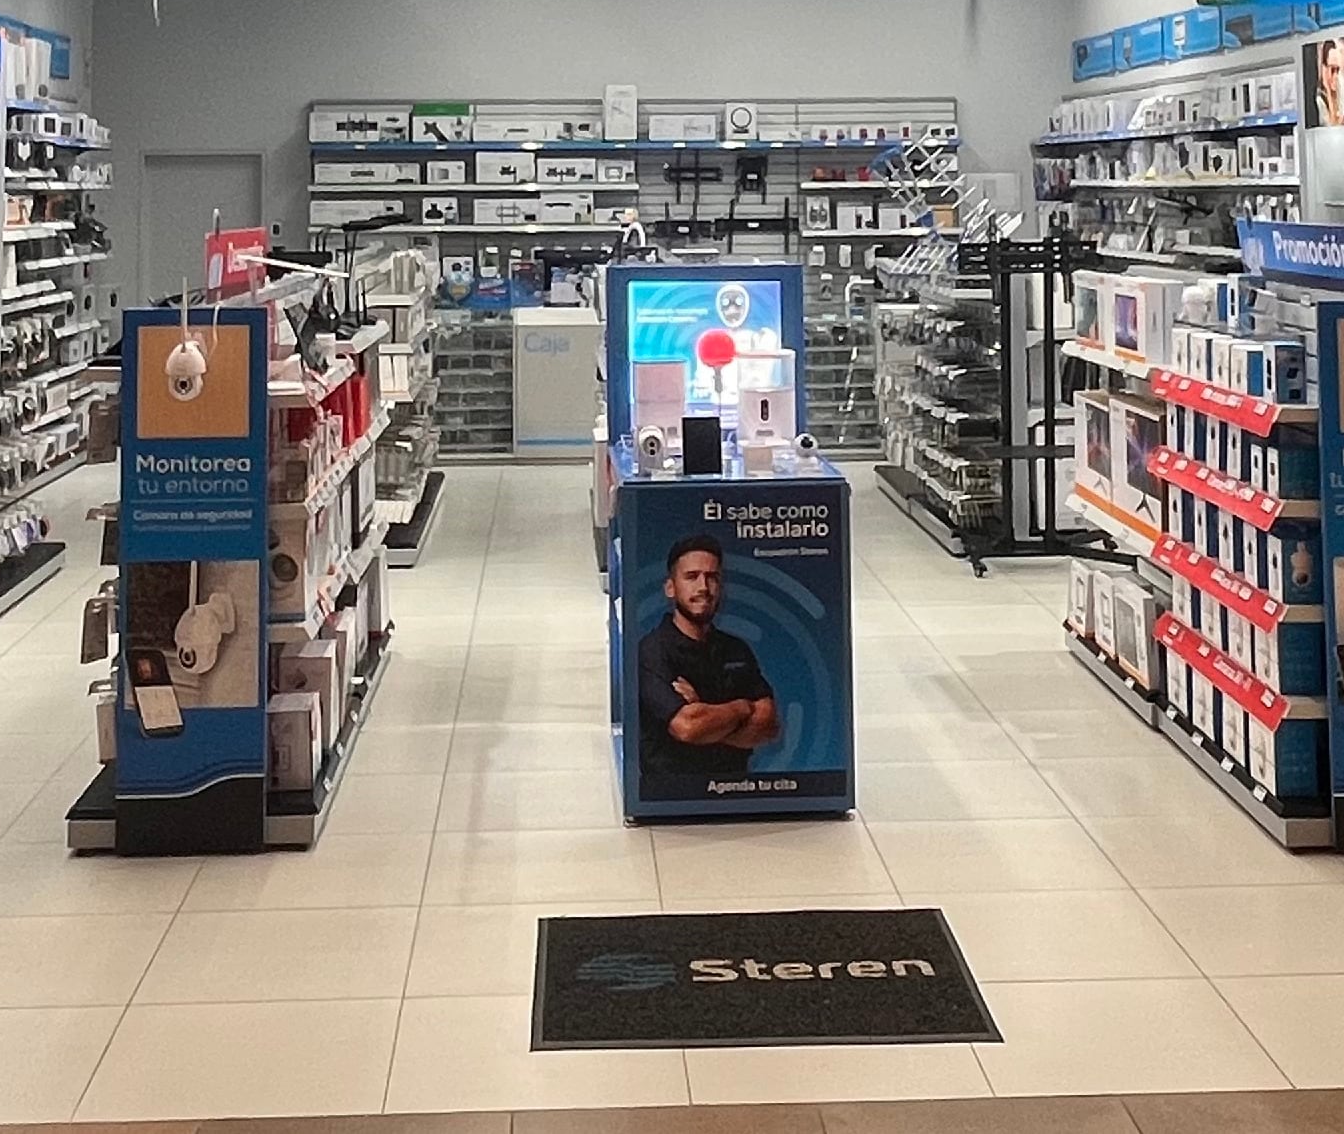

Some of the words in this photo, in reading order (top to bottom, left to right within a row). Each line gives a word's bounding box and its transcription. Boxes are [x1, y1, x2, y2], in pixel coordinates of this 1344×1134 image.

[524, 331, 570, 355] Caja
[135, 453, 252, 474] Monitorea
[138, 478, 158, 495] tu
[164, 476, 249, 495] entorno
[703, 498, 722, 520] Él
[726, 502, 773, 520] sabe
[776, 504, 830, 520] como
[736, 518, 830, 539] instalarlo
[706, 779, 756, 794] Agenda
[758, 779, 772, 791] tu
[773, 778, 798, 791] cita
[688, 956, 937, 984] Steren
